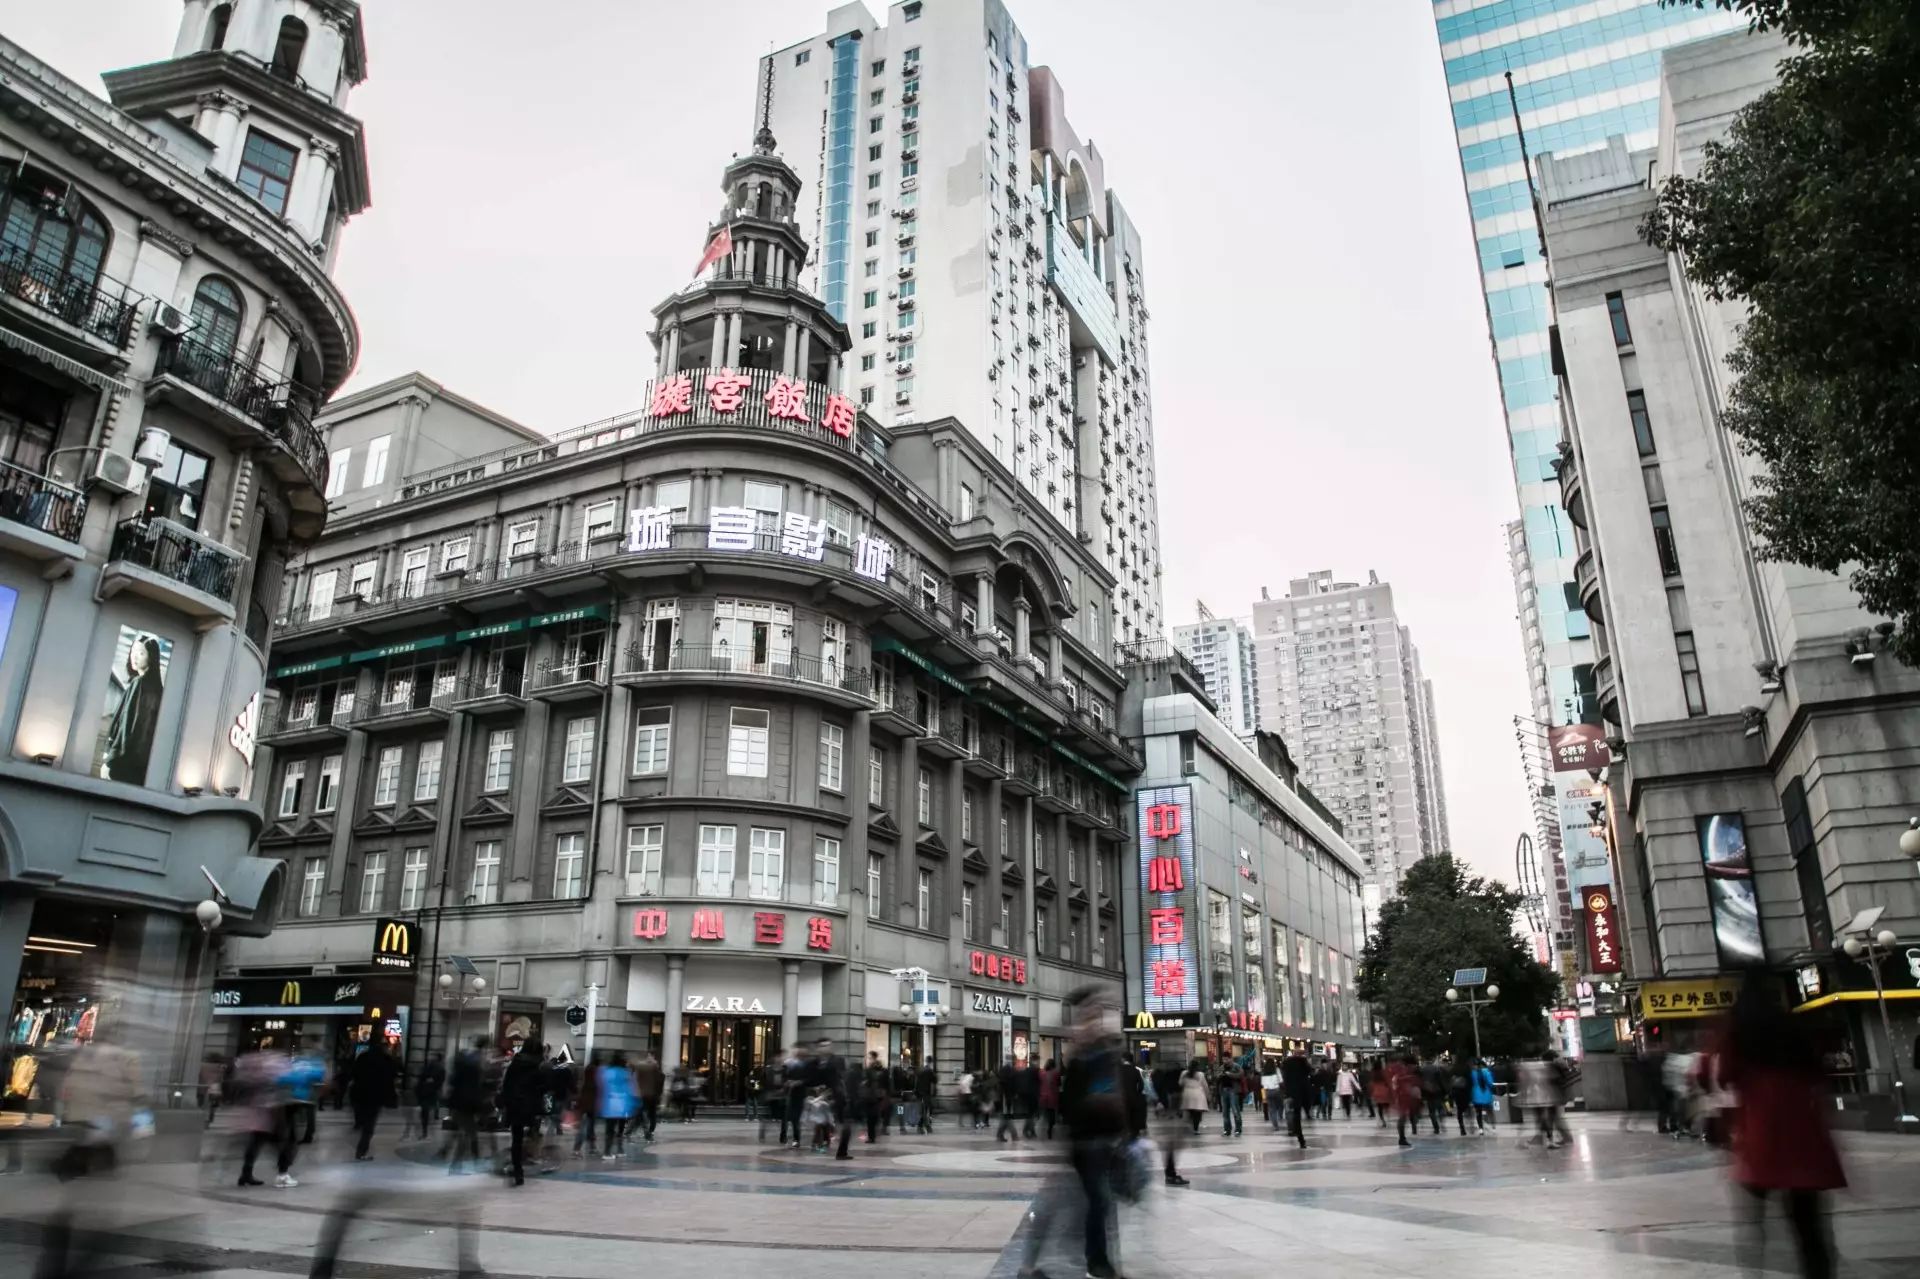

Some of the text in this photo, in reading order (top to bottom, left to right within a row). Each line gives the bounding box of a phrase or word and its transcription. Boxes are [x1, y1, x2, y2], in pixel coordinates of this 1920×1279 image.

[1147, 803, 1185, 996] 中心百货
[634, 908, 834, 951] 中心百货
[1594, 912, 1613, 964] 永和大王
[970, 950, 1026, 985] 中心百货
[686, 995, 767, 1013] ZARA
[973, 992, 1014, 1016] ZARA
